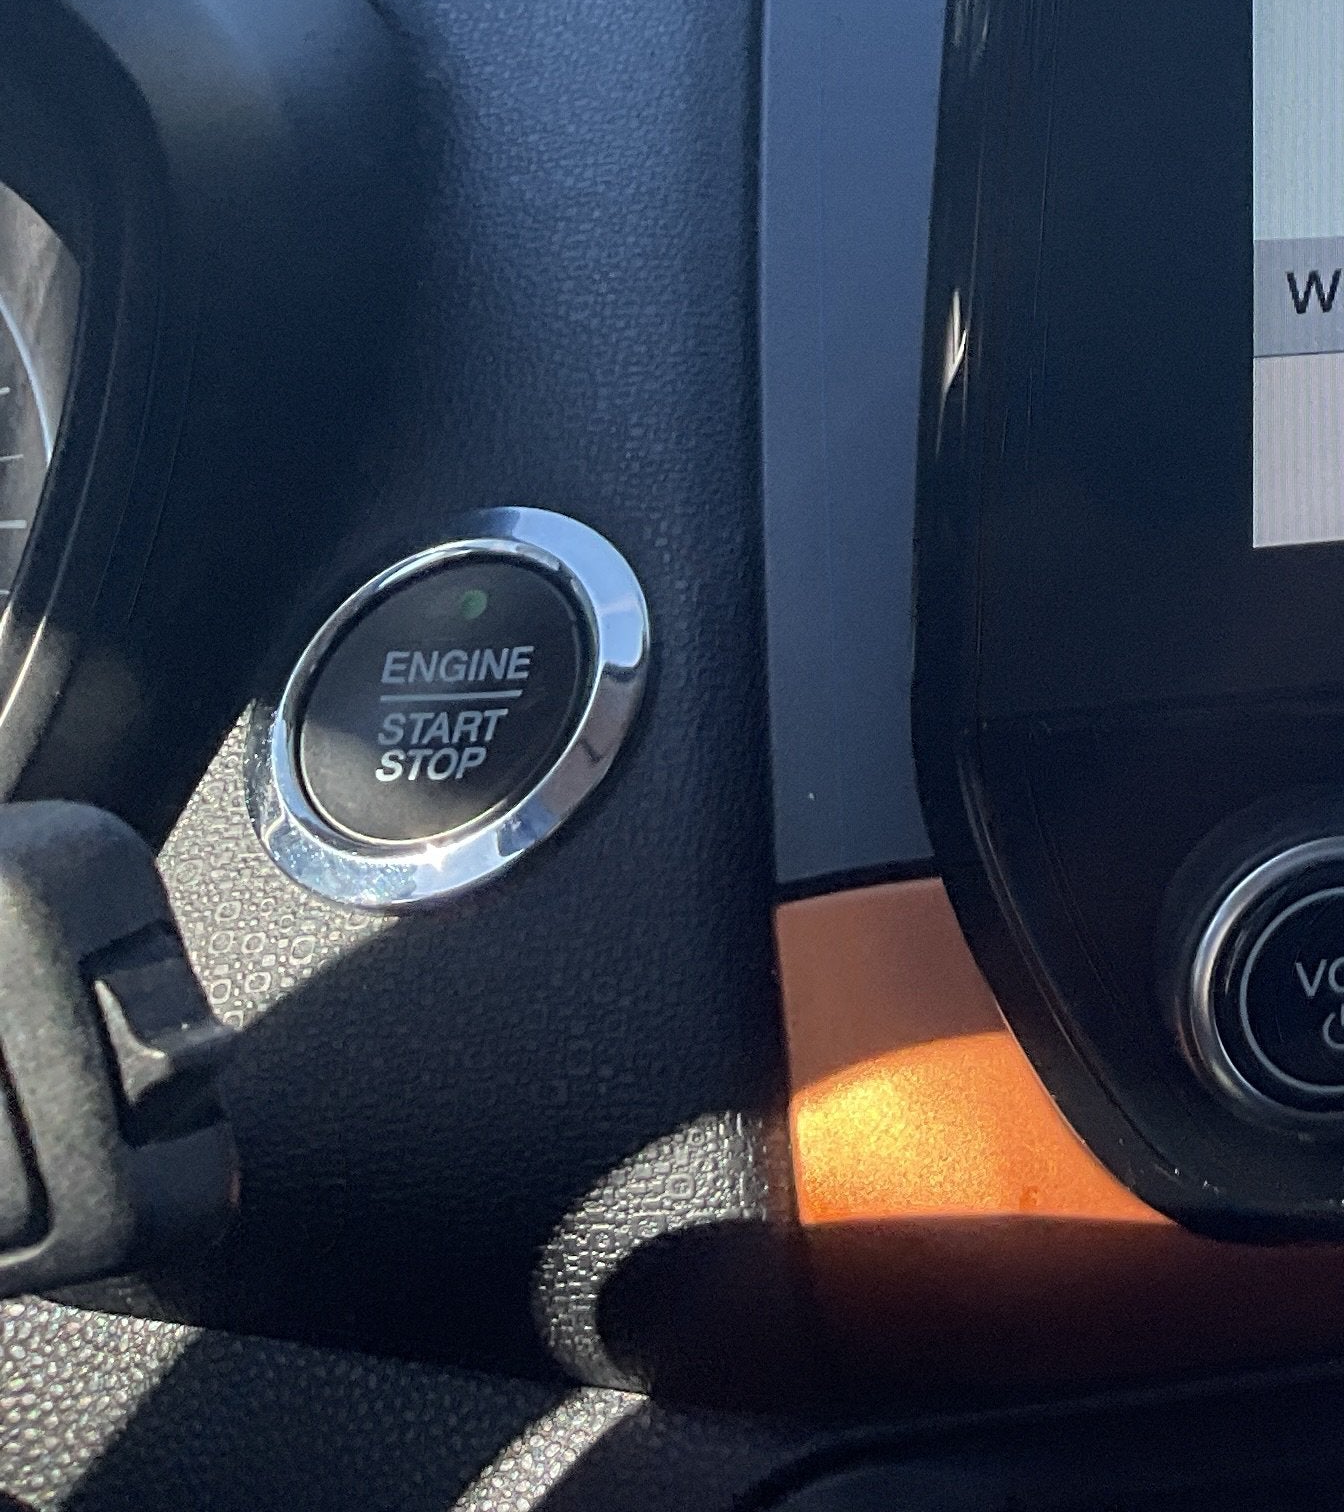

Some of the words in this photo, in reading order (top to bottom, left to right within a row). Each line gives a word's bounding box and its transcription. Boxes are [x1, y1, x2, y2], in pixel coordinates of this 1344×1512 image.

[1286, 269, 1341, 315] W
[381, 646, 534, 684] ENGINE
[377, 708, 509, 746] START
[374, 746, 487, 783] STOP
